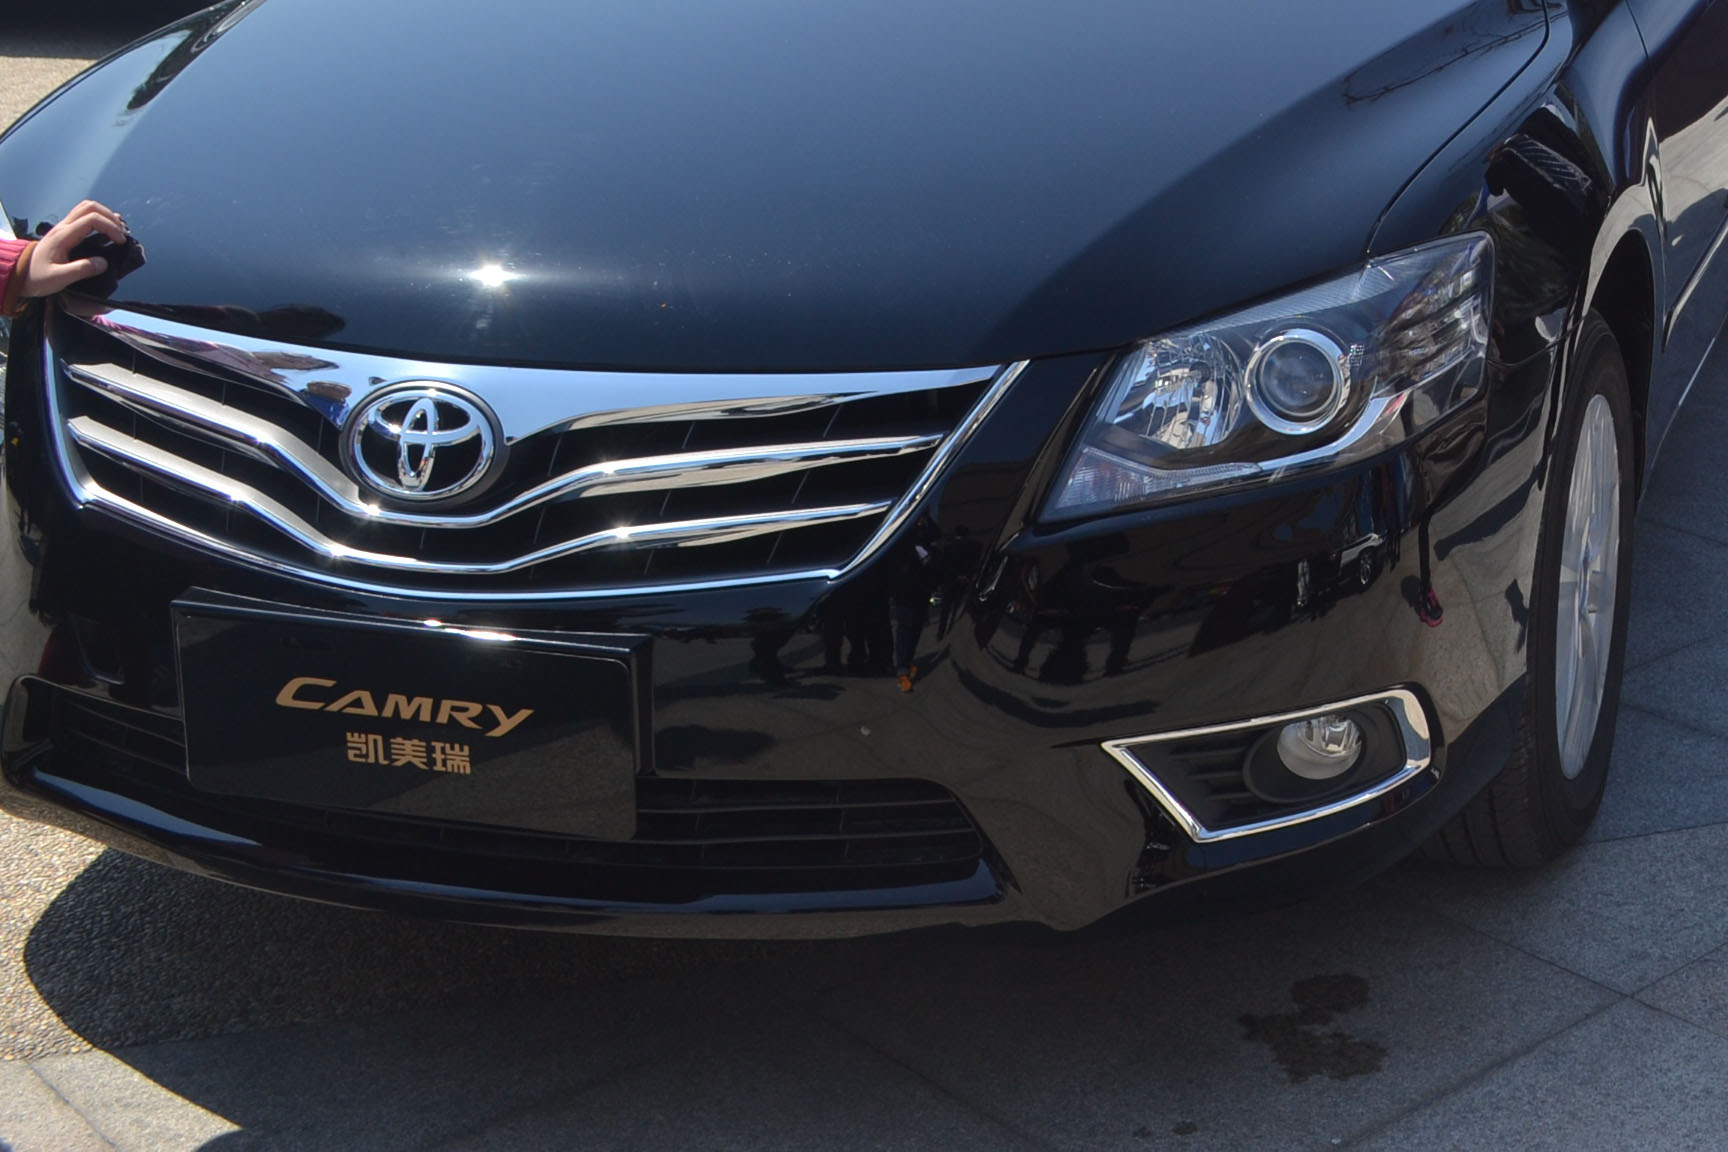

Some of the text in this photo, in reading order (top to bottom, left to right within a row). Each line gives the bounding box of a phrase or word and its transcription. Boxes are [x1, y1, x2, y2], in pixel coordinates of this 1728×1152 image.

[275, 675, 535, 737] CAMRY
[345, 731, 472, 775] 凯美瑞
